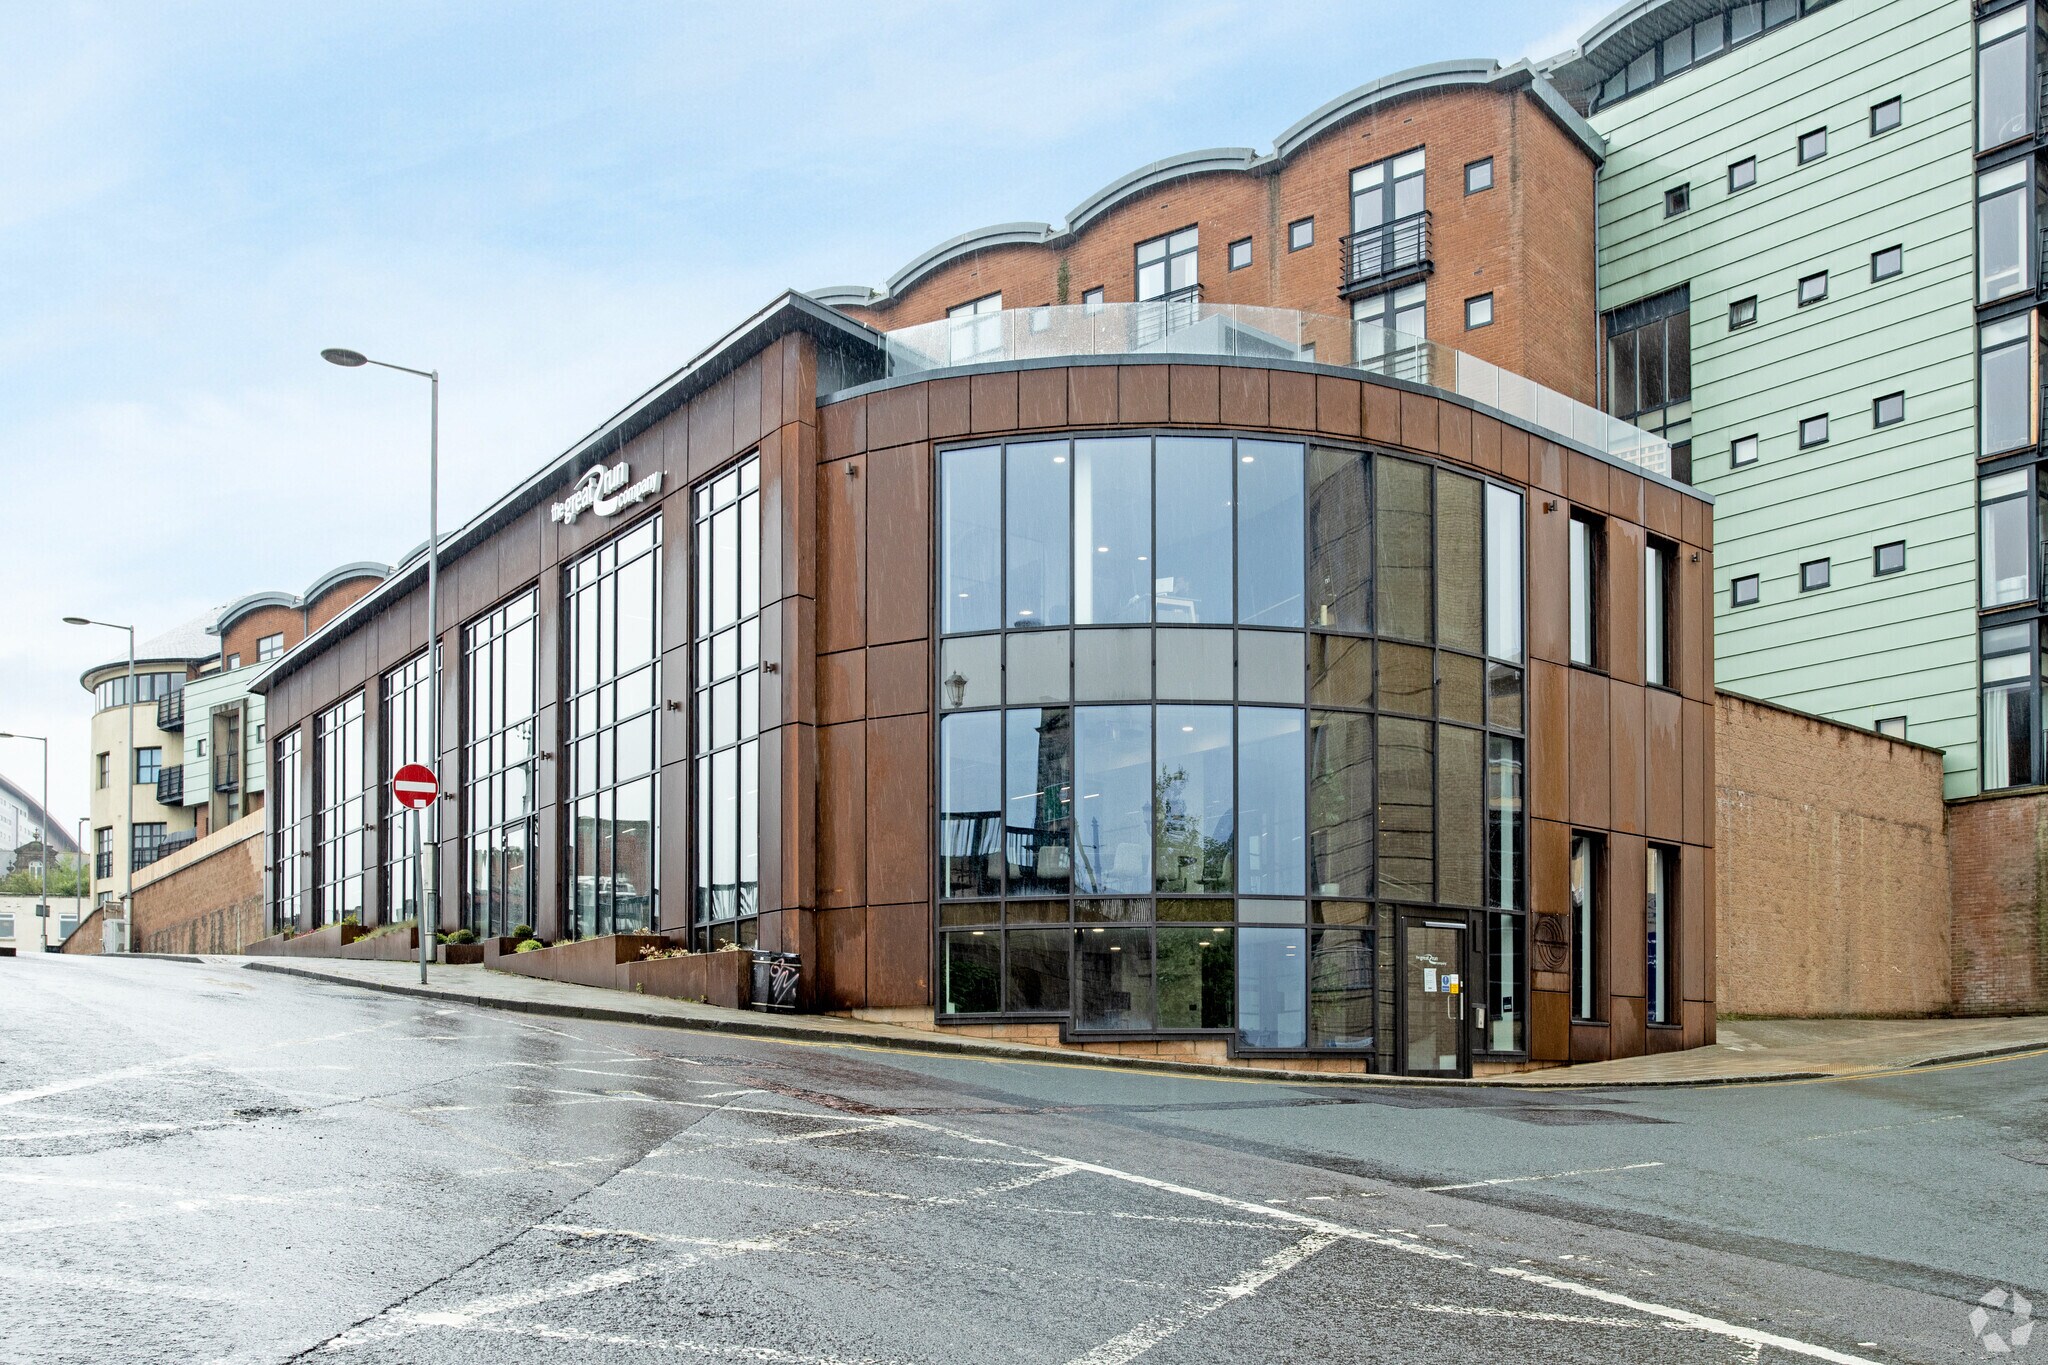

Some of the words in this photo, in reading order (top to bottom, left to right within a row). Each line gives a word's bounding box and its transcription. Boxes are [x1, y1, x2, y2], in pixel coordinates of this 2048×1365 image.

[551, 502, 565, 522] the
[564, 477, 597, 525] great
[604, 462, 629, 495] run
[617, 471, 662, 508] company
